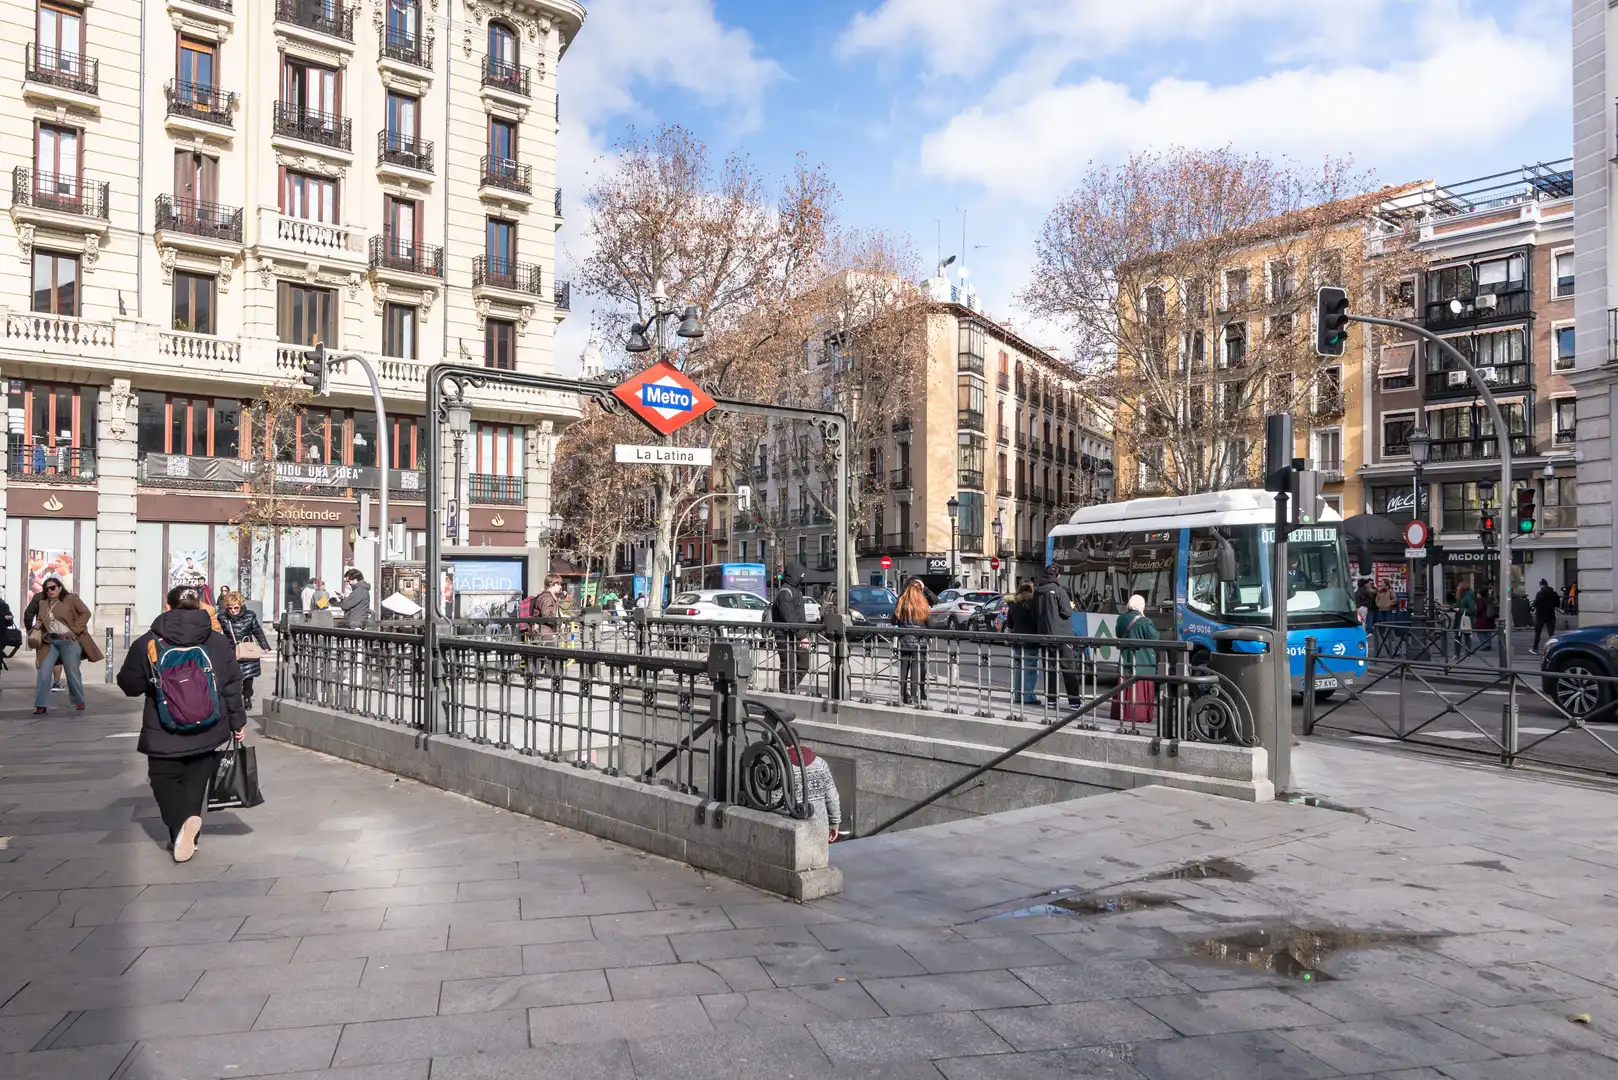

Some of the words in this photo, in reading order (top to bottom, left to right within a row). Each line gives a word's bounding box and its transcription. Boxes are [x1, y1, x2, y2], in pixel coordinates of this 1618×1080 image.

[647, 387, 689, 407] Metro
[636, 449, 651, 460] La
[656, 449, 694, 461] Latina
[308, 466, 328, 478] UNA
[276, 508, 341, 521] Santander
[1288, 529, 1312, 542] UERTA
[1313, 528, 1337, 541] TOLEDO
[1448, 552, 1513, 561] McDonal
[930, 559, 947, 568] 100
[1196, 624, 1211, 634] 9014
